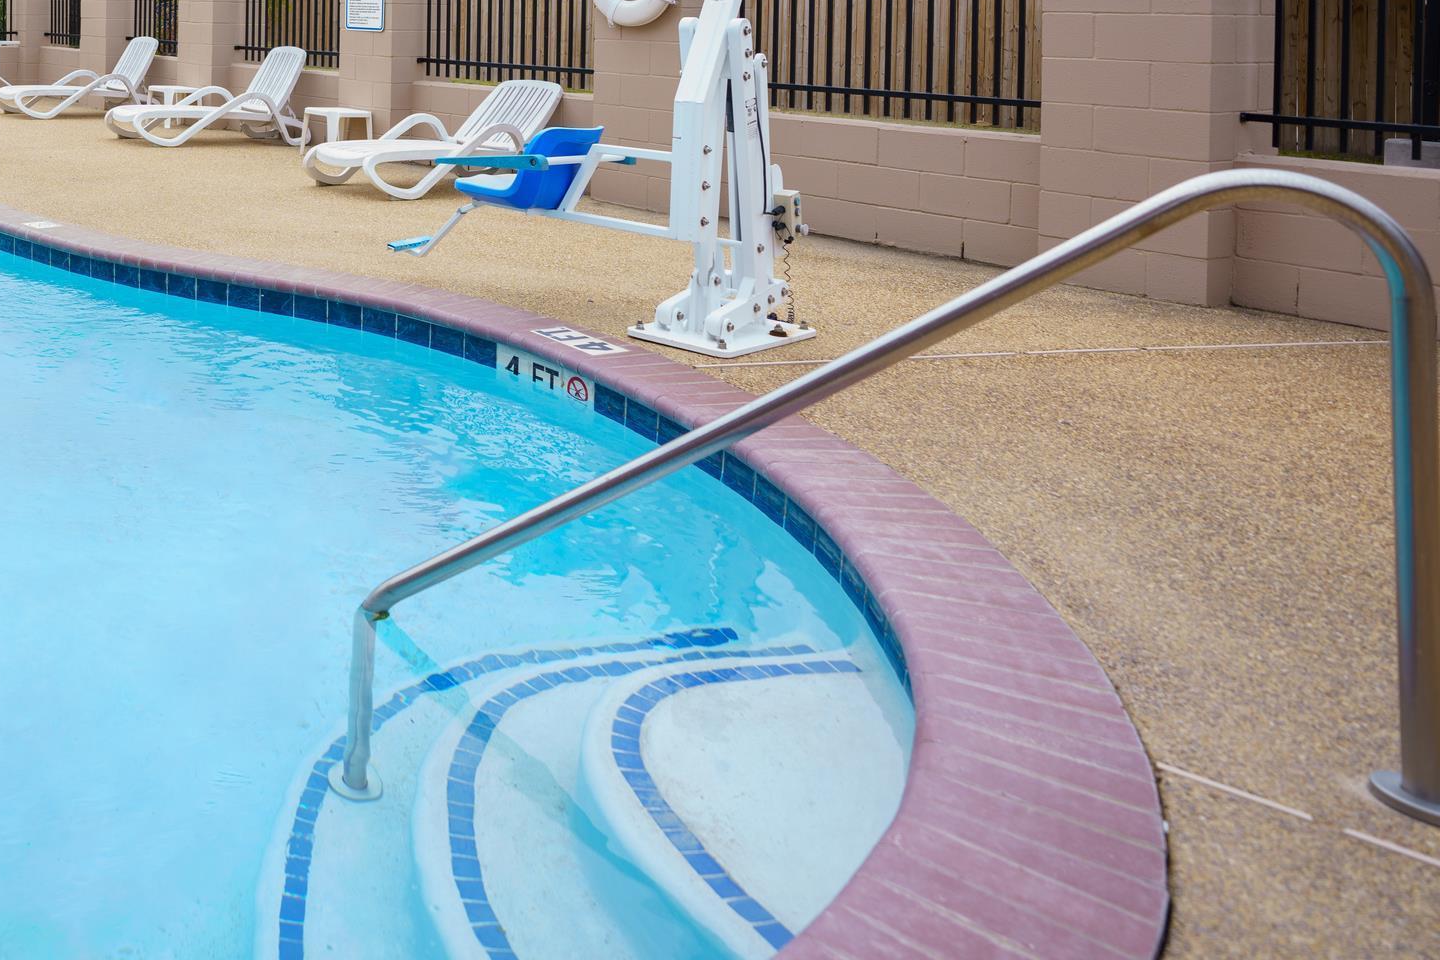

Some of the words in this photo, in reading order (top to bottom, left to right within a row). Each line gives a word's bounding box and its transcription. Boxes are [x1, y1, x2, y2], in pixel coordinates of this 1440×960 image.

[574, 341, 614, 352] 4
[505, 355, 521, 376] 4
[532, 361, 560, 390] FT
